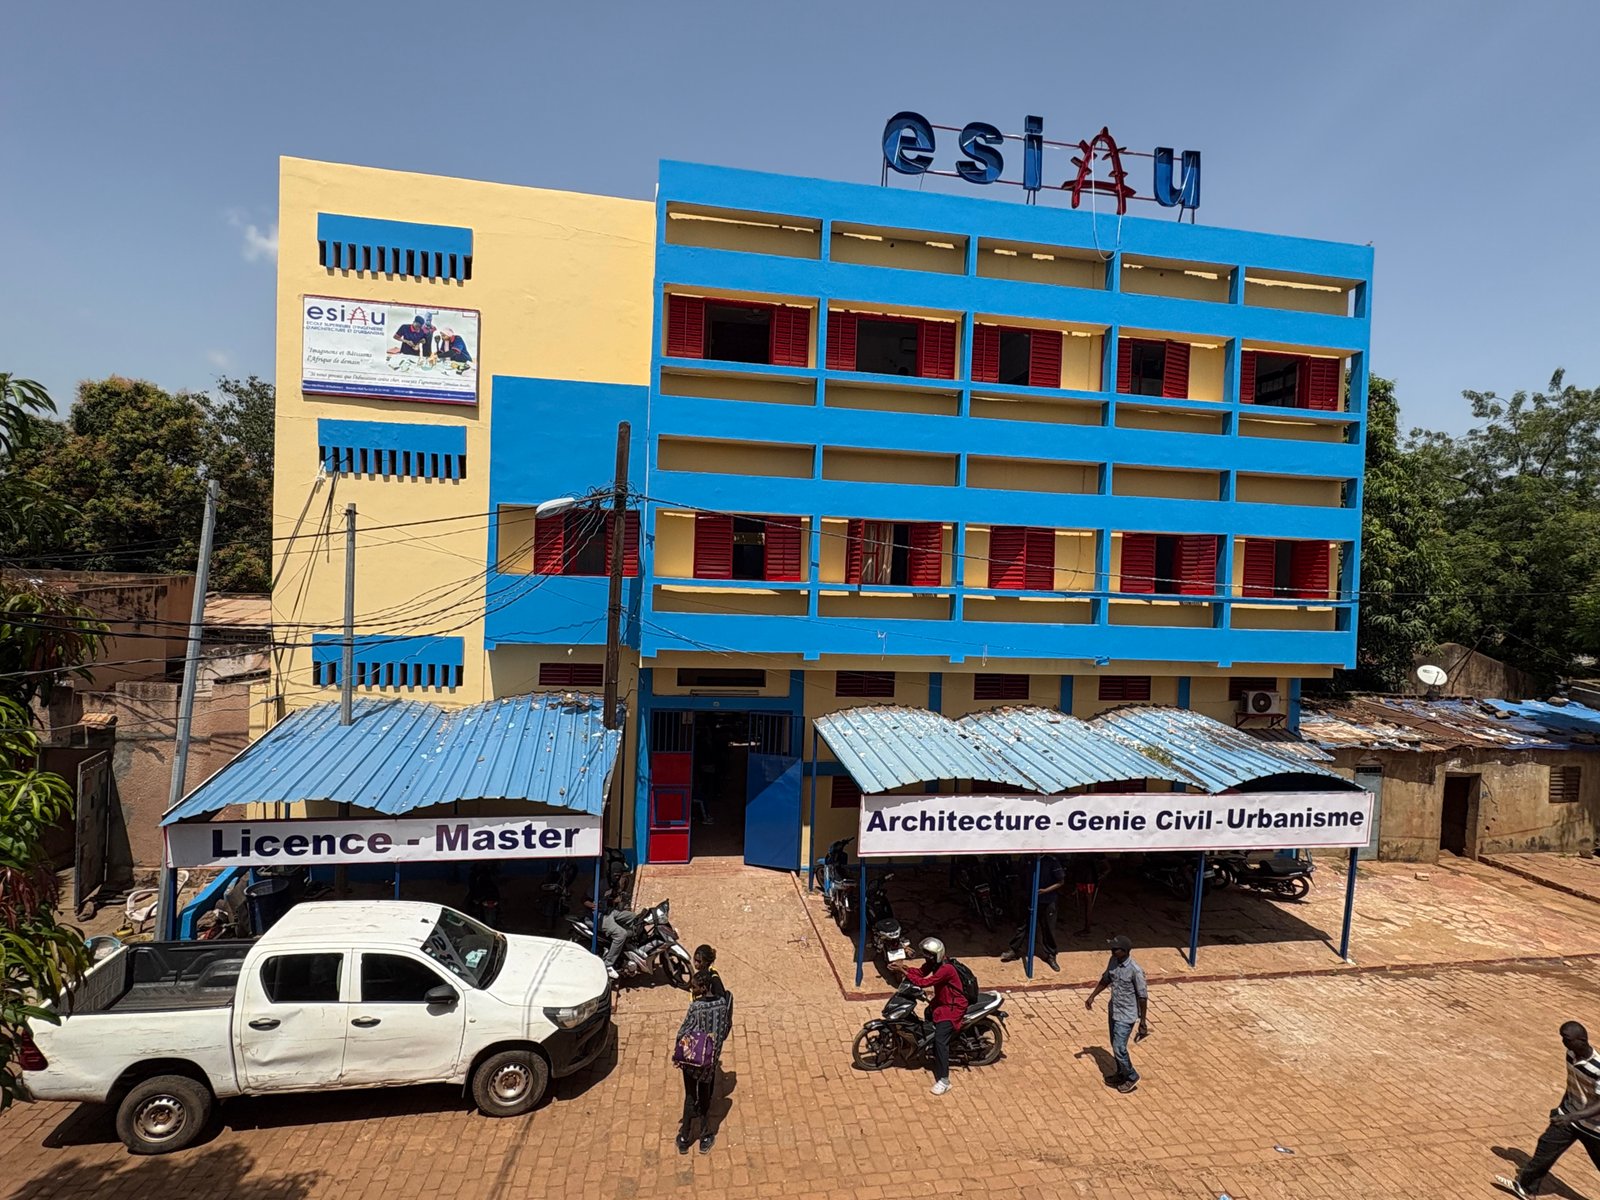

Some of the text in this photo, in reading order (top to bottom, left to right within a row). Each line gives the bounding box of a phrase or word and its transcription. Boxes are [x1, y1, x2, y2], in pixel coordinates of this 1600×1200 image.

[866, 809, 1051, 832] Architecture
[211, 828, 394, 858] Licence
[435, 823, 581, 852] Master
